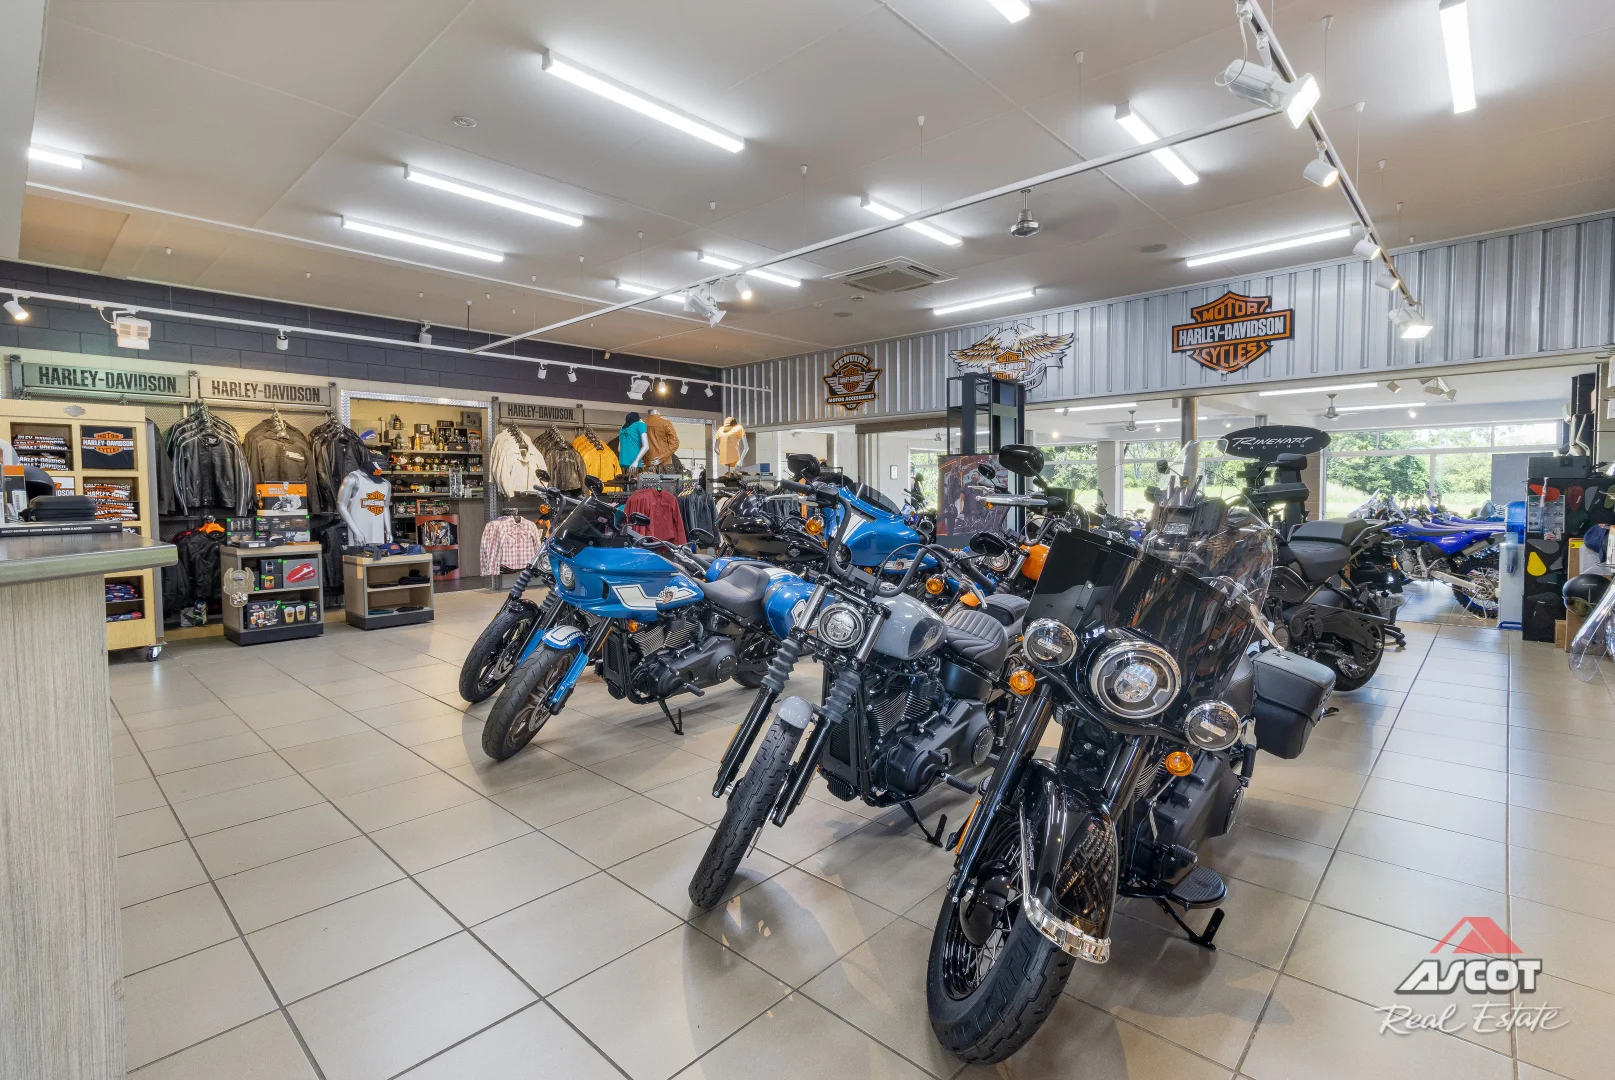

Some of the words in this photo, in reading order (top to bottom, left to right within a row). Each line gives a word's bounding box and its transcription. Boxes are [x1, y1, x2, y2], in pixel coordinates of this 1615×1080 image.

[1203, 300, 1260, 321] MOTOR
[1178, 316, 1285, 347] HARLEY-DAVIDSON
[833, 354, 869, 370] GENUINE
[1201, 342, 1258, 367] CYCLES
[38, 366, 177, 394] HARLEY-DAVIDSON
[211, 380, 321, 403] HARLEY-DAVIDSON
[507, 403, 574, 421] HARLEY-DAVIDSON
[82, 439, 134, 447] HARLEY-DAVIDSON
